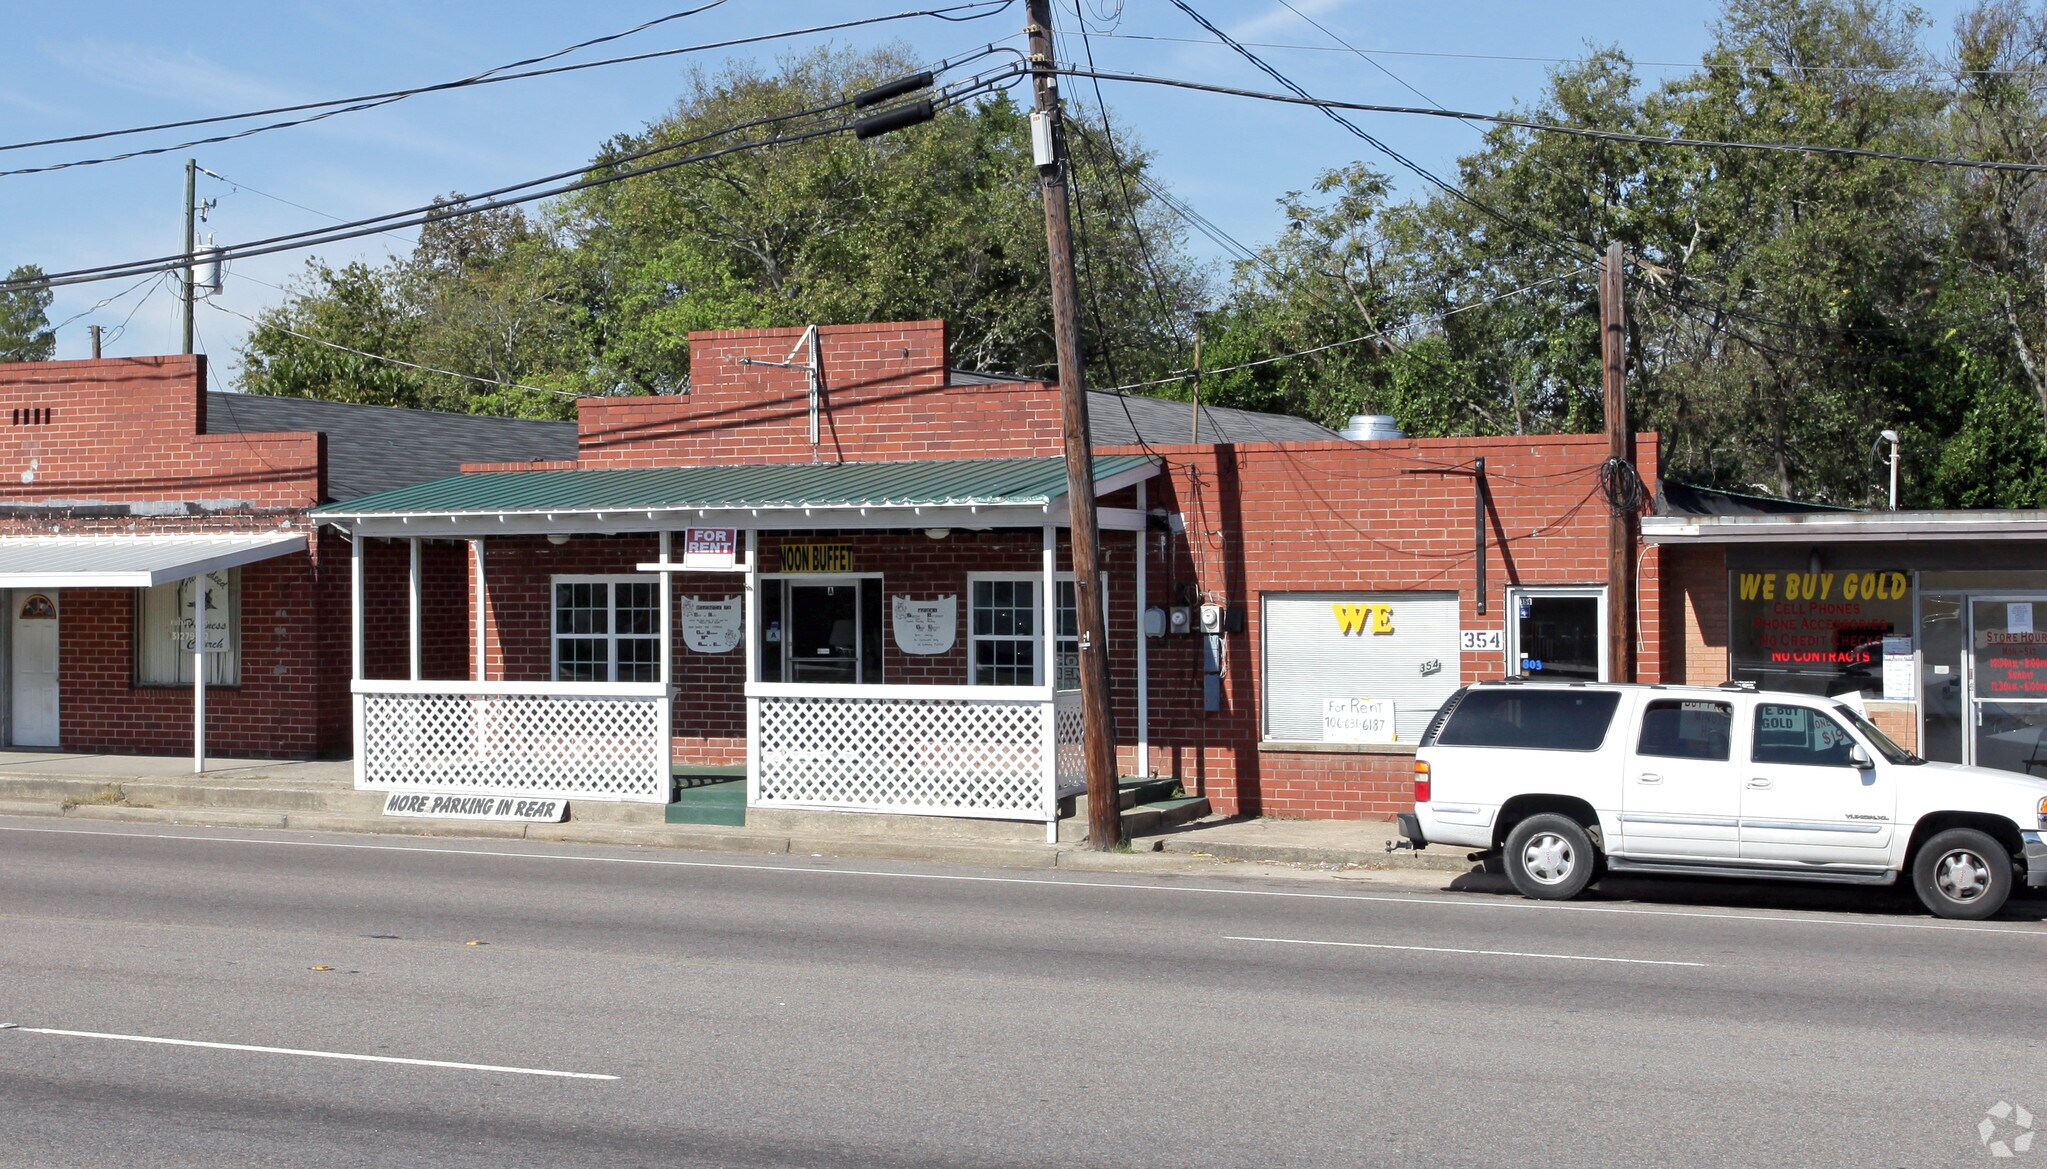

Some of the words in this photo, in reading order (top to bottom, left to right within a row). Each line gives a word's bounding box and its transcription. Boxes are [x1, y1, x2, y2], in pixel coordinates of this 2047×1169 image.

[694, 530, 726, 541] FOR
[689, 542, 731, 553] RENT
[779, 545, 809, 571] NOON
[813, 545, 853, 571] BUFFET
[1740, 573, 1777, 600] WE
[1786, 573, 1834, 600] BUY
[1843, 572, 1907, 600] GOLD
[1774, 602, 1805, 615] CELL
[1809, 602, 1861, 615] PHONES
[1331, 604, 1393, 634] WE
[1464, 632, 1500, 648] 354
[1987, 632, 2018, 642] STORE
[2021, 632, 2047, 642] HOUR
[1772, 650, 1790, 662] NO
[1793, 649, 1871, 662] CONTRACTS
[1420, 659, 1438, 673] 354
[1522, 659, 1542, 670] 803
[1329, 701, 1346, 712] For
[1763, 718, 1793, 729] GOLD
[386, 795, 430, 812] MORE
[431, 796, 494, 815] PARKING
[495, 799, 514, 815] IN
[514, 800, 556, 817] REAR
